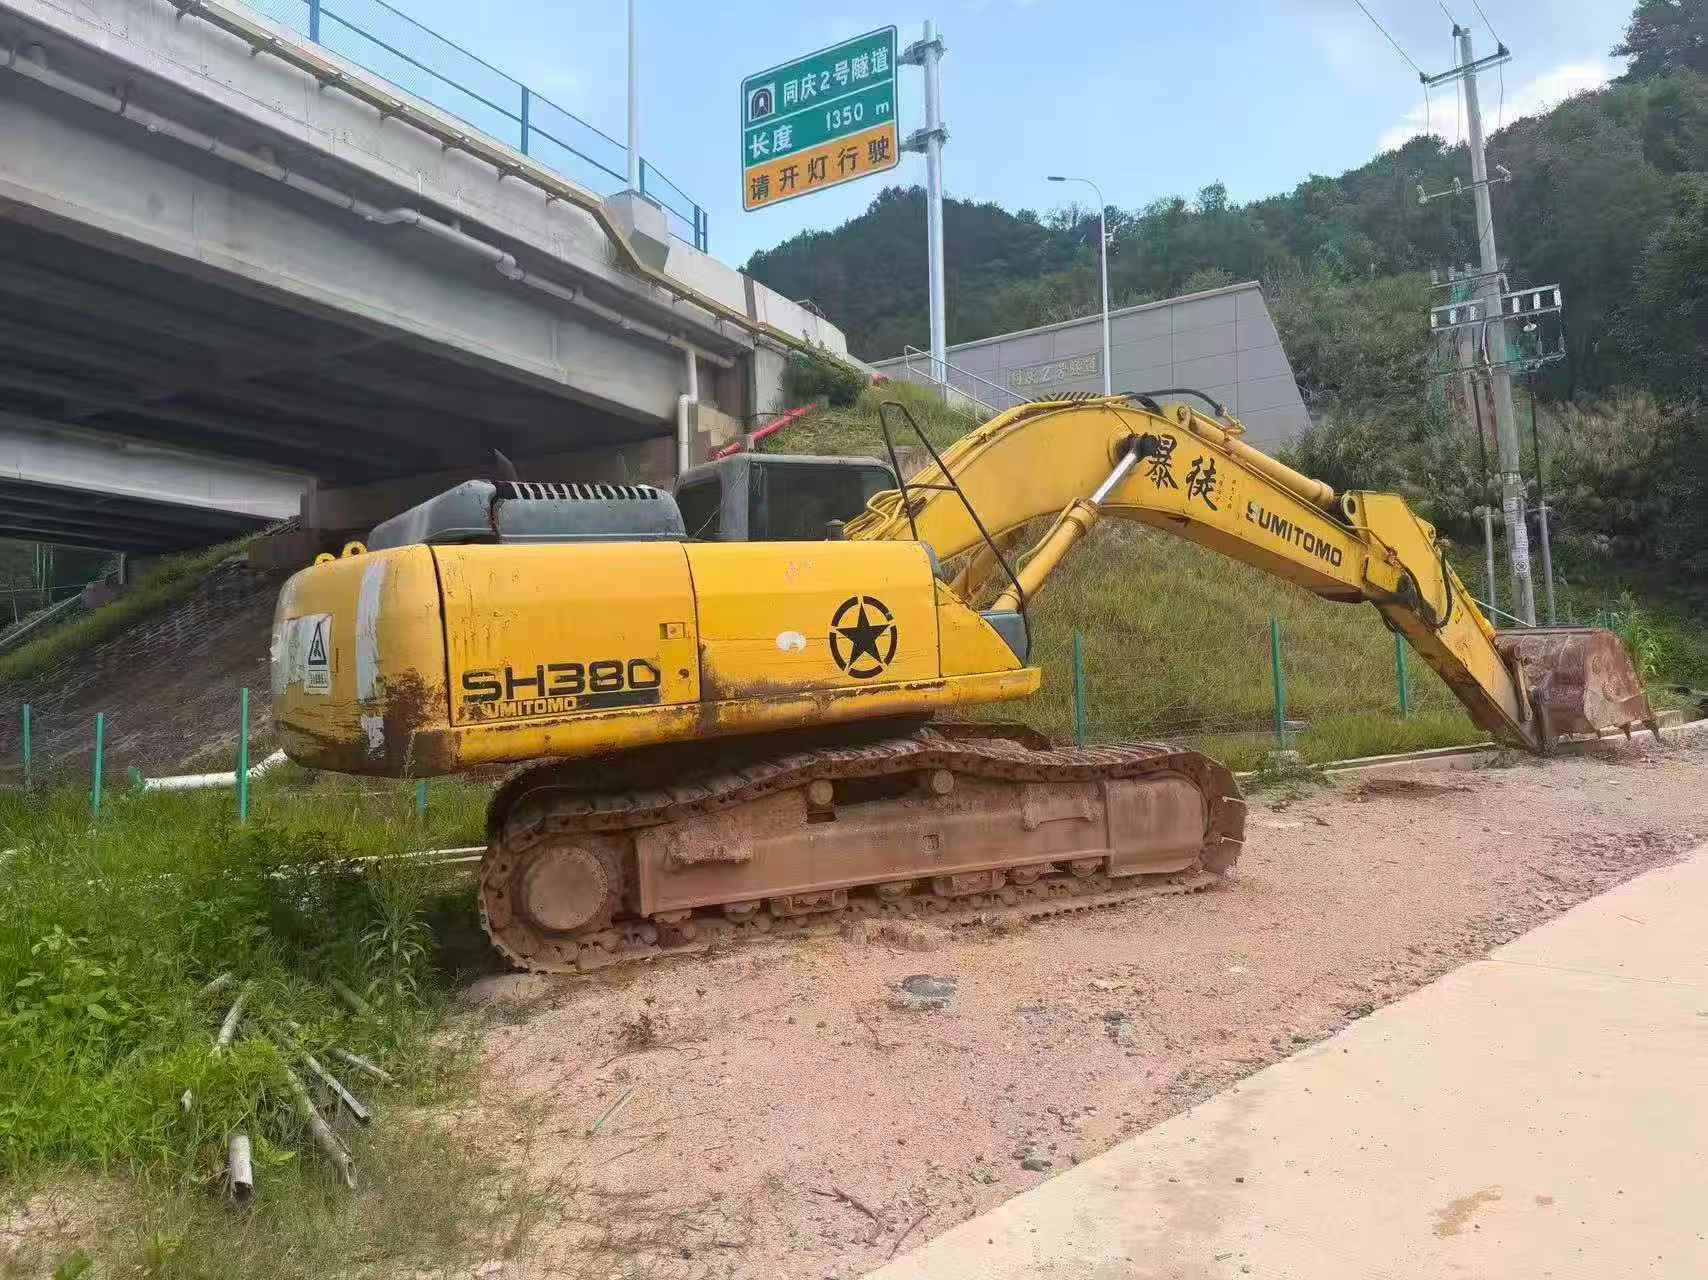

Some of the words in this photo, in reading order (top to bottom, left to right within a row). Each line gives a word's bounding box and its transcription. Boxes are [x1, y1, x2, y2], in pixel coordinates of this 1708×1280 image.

[783, 46, 889, 107] 同庆2号隧道
[749, 124, 793, 159] 长度
[825, 102, 864, 131] 1350
[875, 101, 889, 115] m
[750, 135, 890, 200] 请开灯行驶
[462, 658, 661, 702] SH380
[471, 697, 578, 719] UMITOMO
